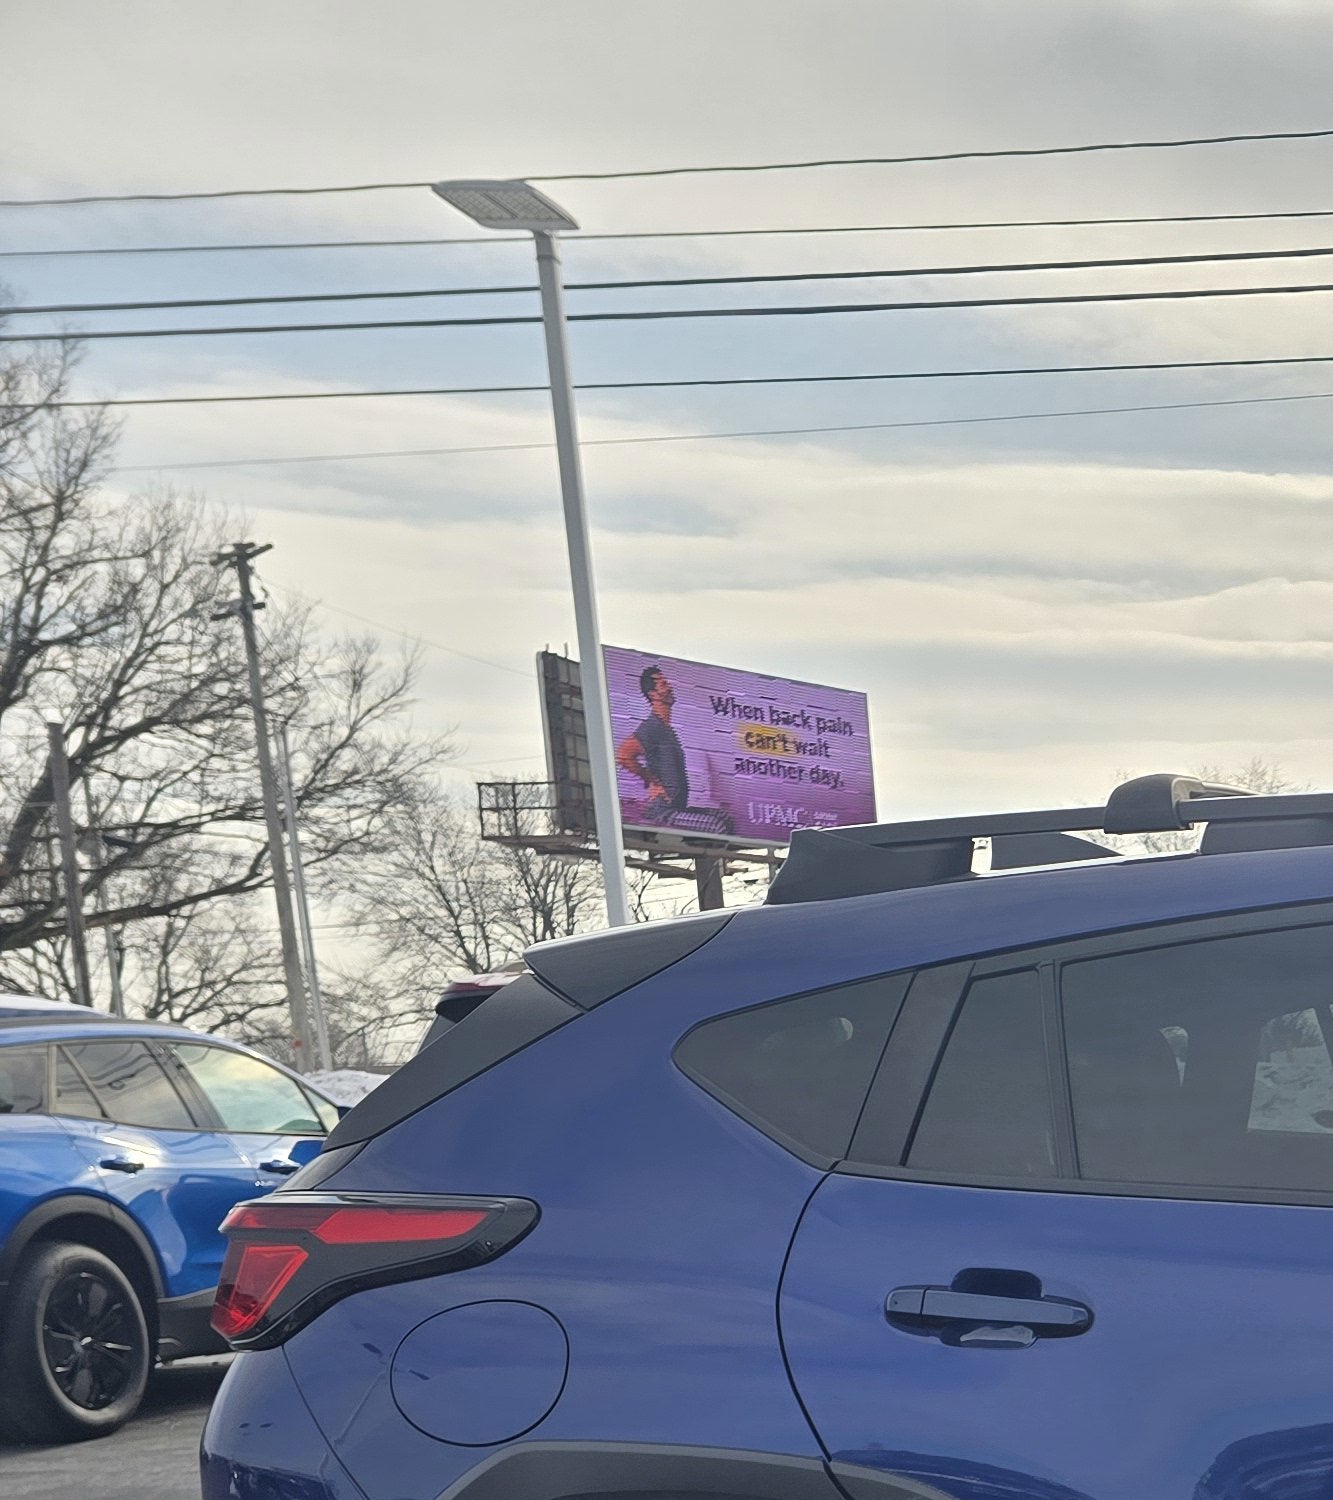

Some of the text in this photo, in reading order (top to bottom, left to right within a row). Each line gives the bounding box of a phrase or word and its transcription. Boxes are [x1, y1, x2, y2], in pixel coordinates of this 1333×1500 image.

[711, 696, 853, 736] When back pain
[744, 730, 831, 758] can't wait
[734, 757, 844, 789] another day.
